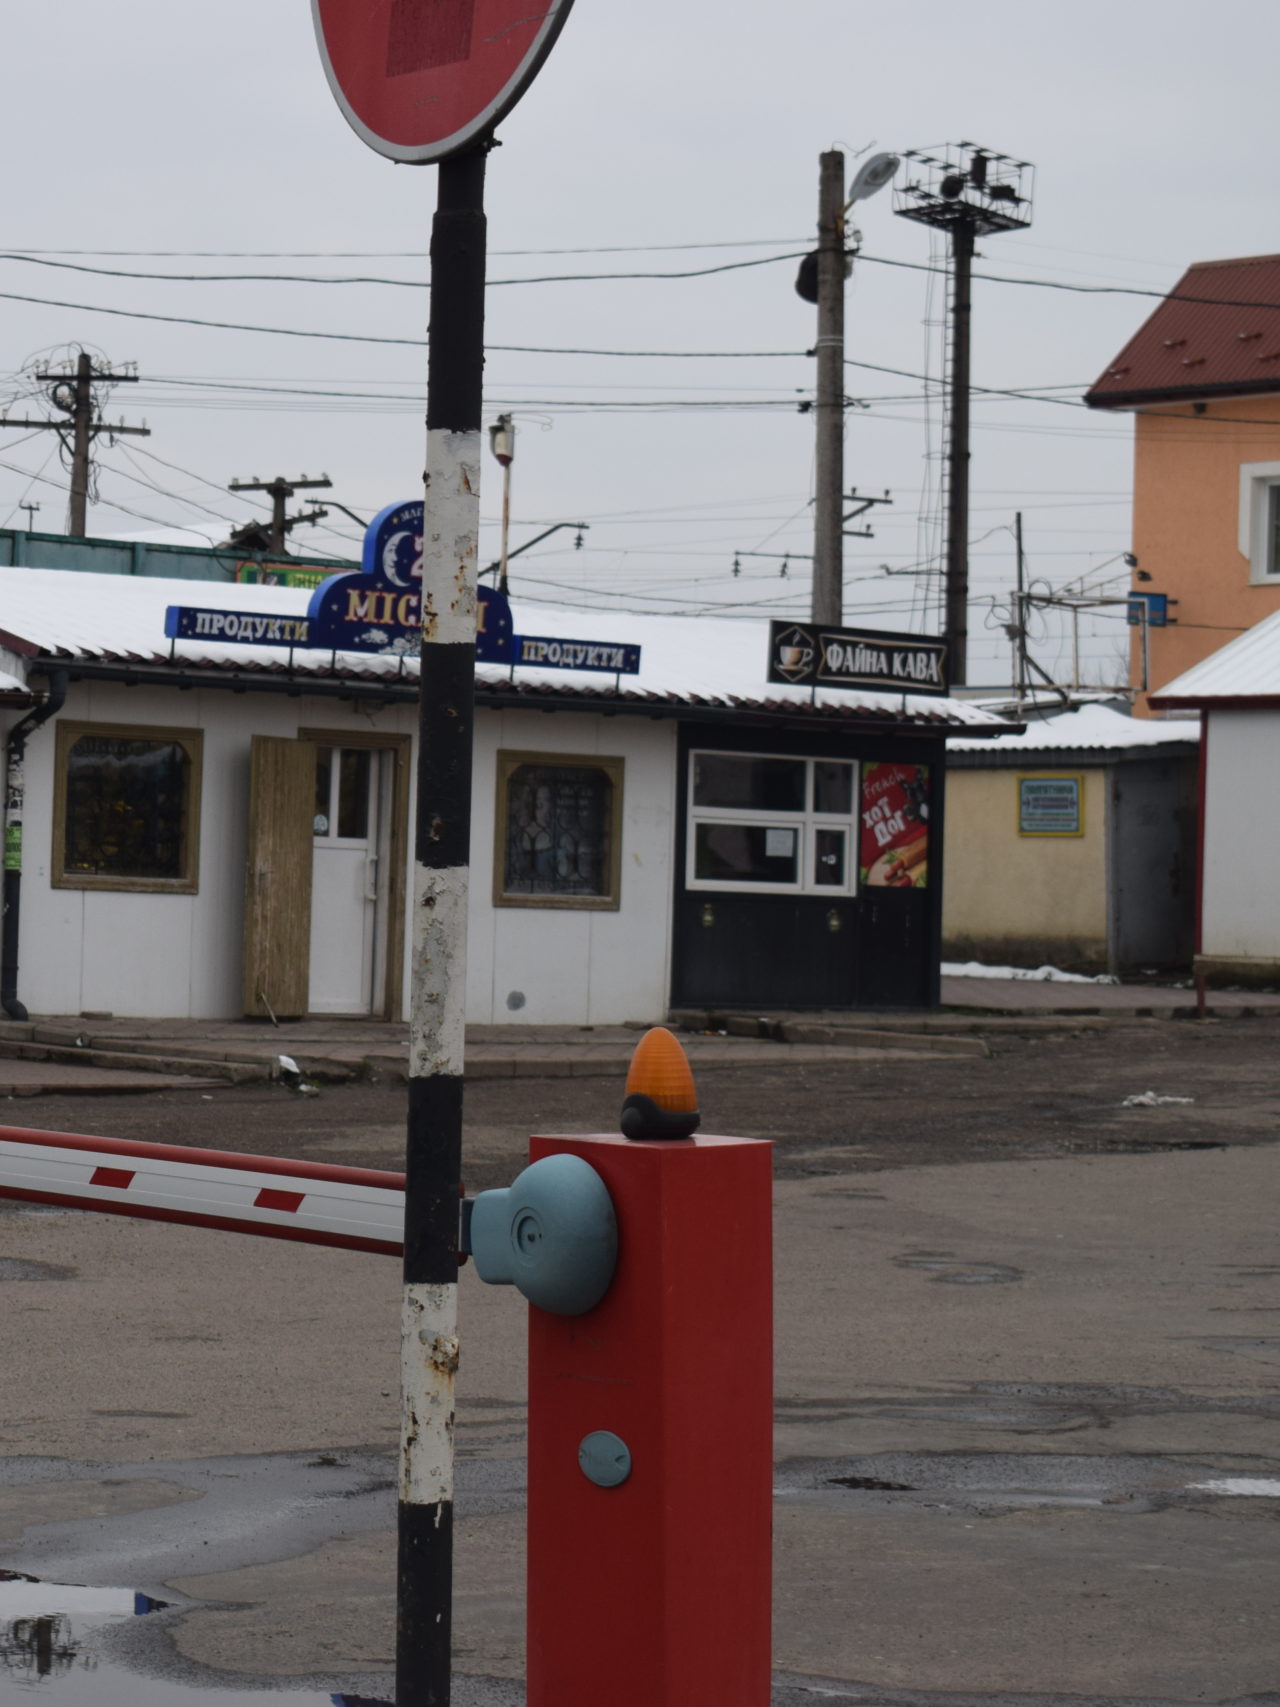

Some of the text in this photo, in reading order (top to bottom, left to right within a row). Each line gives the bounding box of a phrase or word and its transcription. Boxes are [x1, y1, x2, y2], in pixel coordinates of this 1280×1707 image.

[195, 612, 309, 641] ПРОДУКТИ
[344, 588, 488, 633] МІСІ
[522, 641, 624, 668] ПРОДУКТИ
[826, 643, 938, 682] ФАЙНА КАВА
